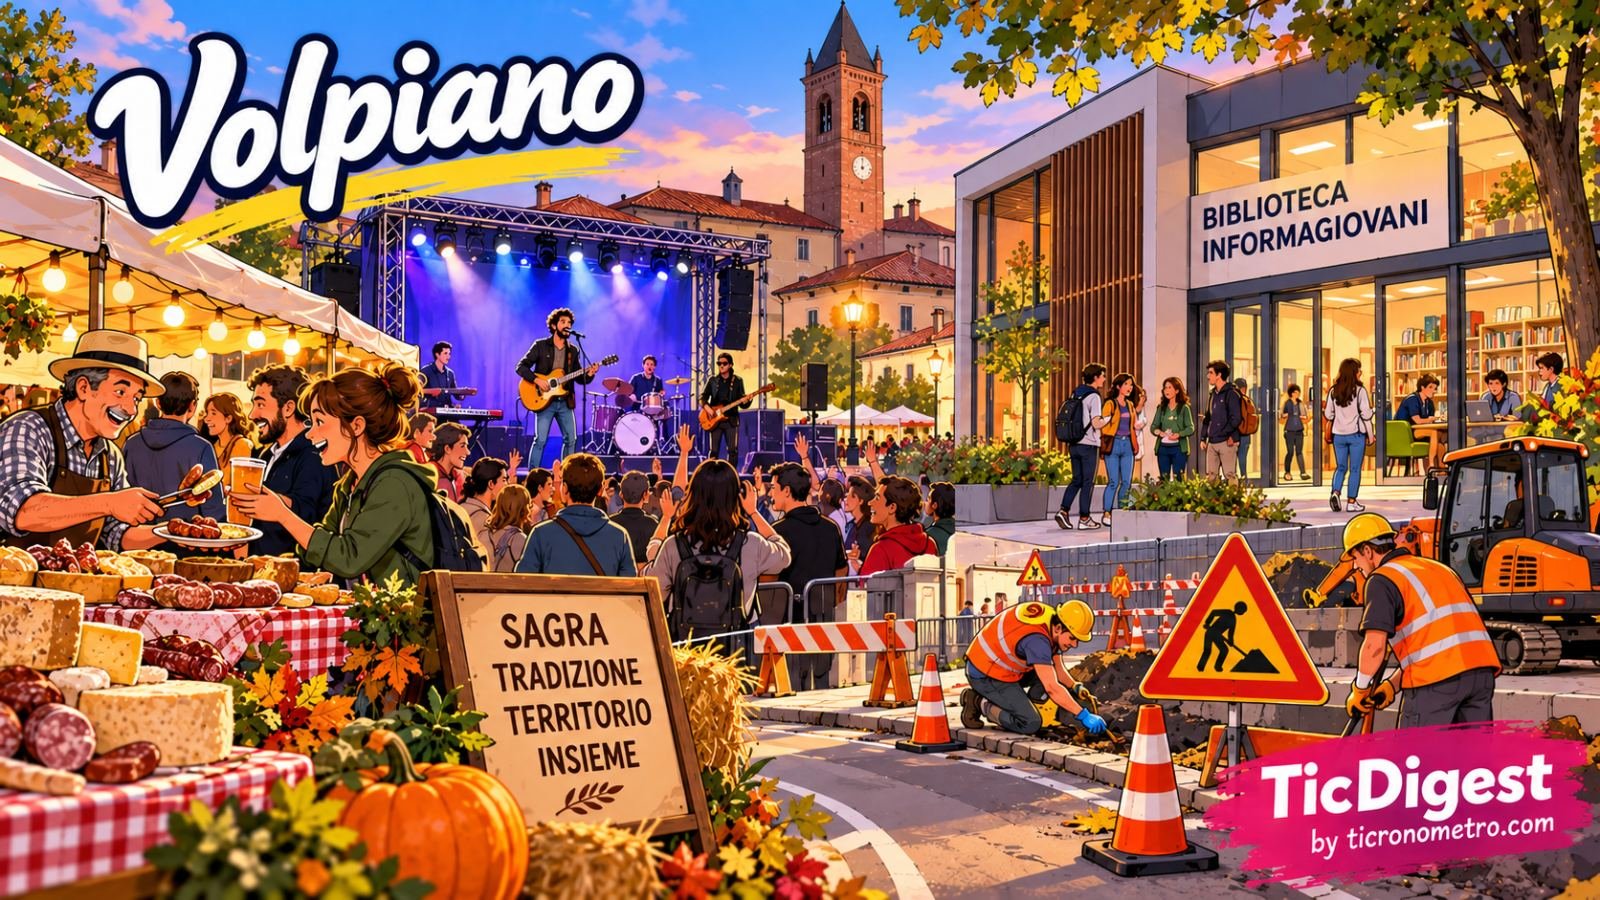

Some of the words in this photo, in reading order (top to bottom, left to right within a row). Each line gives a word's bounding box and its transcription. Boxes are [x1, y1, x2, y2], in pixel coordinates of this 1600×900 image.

[1203, 180, 1349, 231] BIBLIOTECA
[1203, 198, 1428, 264] INFORMAGIOVANI
[501, 612, 609, 649] SAGRA
[491, 657, 642, 692] TRADIZIONE
[503, 697, 652, 736] TERRITORIO
[537, 740, 641, 777] INSIEME
